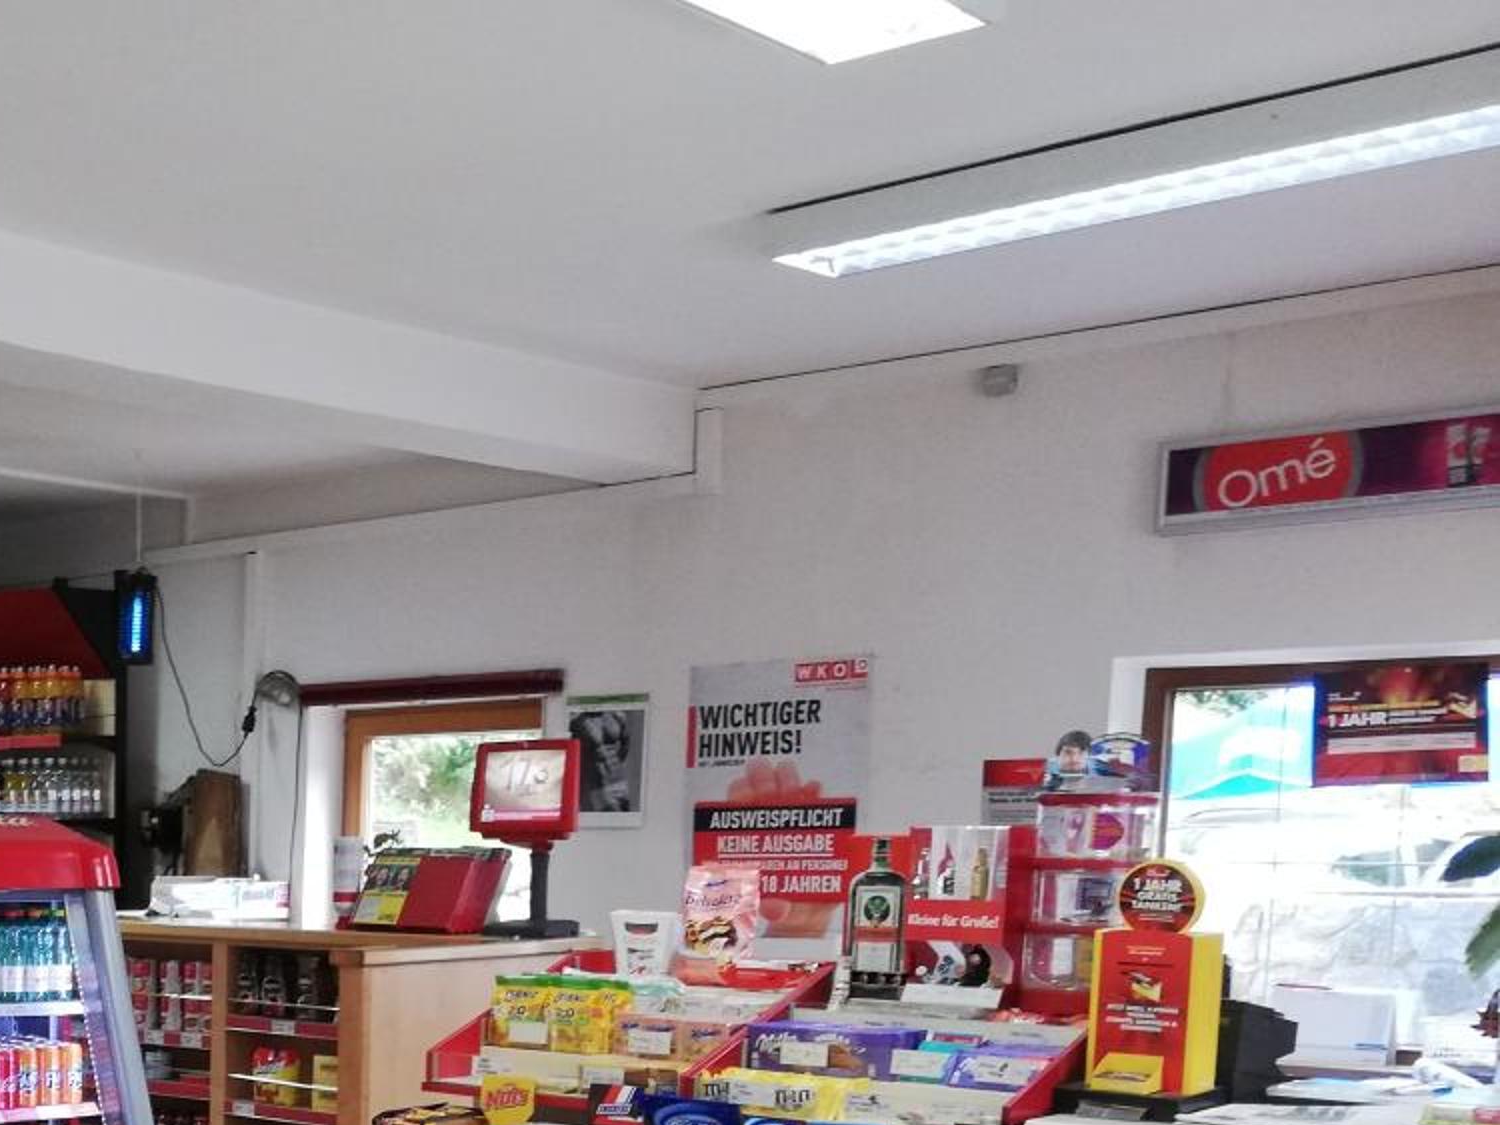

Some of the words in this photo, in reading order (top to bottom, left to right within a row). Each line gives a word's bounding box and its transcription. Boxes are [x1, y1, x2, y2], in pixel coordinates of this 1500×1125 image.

[1217, 437, 1336, 508] Omé
[699, 699, 822, 730] WICHTIGER
[1338, 711, 1387, 727] JAHR
[698, 729, 803, 758] HINWEIS!
[709, 808, 844, 829] AUSWEISPFLICHT
[717, 834, 760, 854] KEINE
[762, 833, 835, 854] AUSGABE
[761, 876, 778, 893] 18
[780, 874, 841, 893] JAHREN
[908, 914, 941, 925] Kleine
[942, 914, 960, 927] für
[484, 1084, 528, 1110] Nuts
